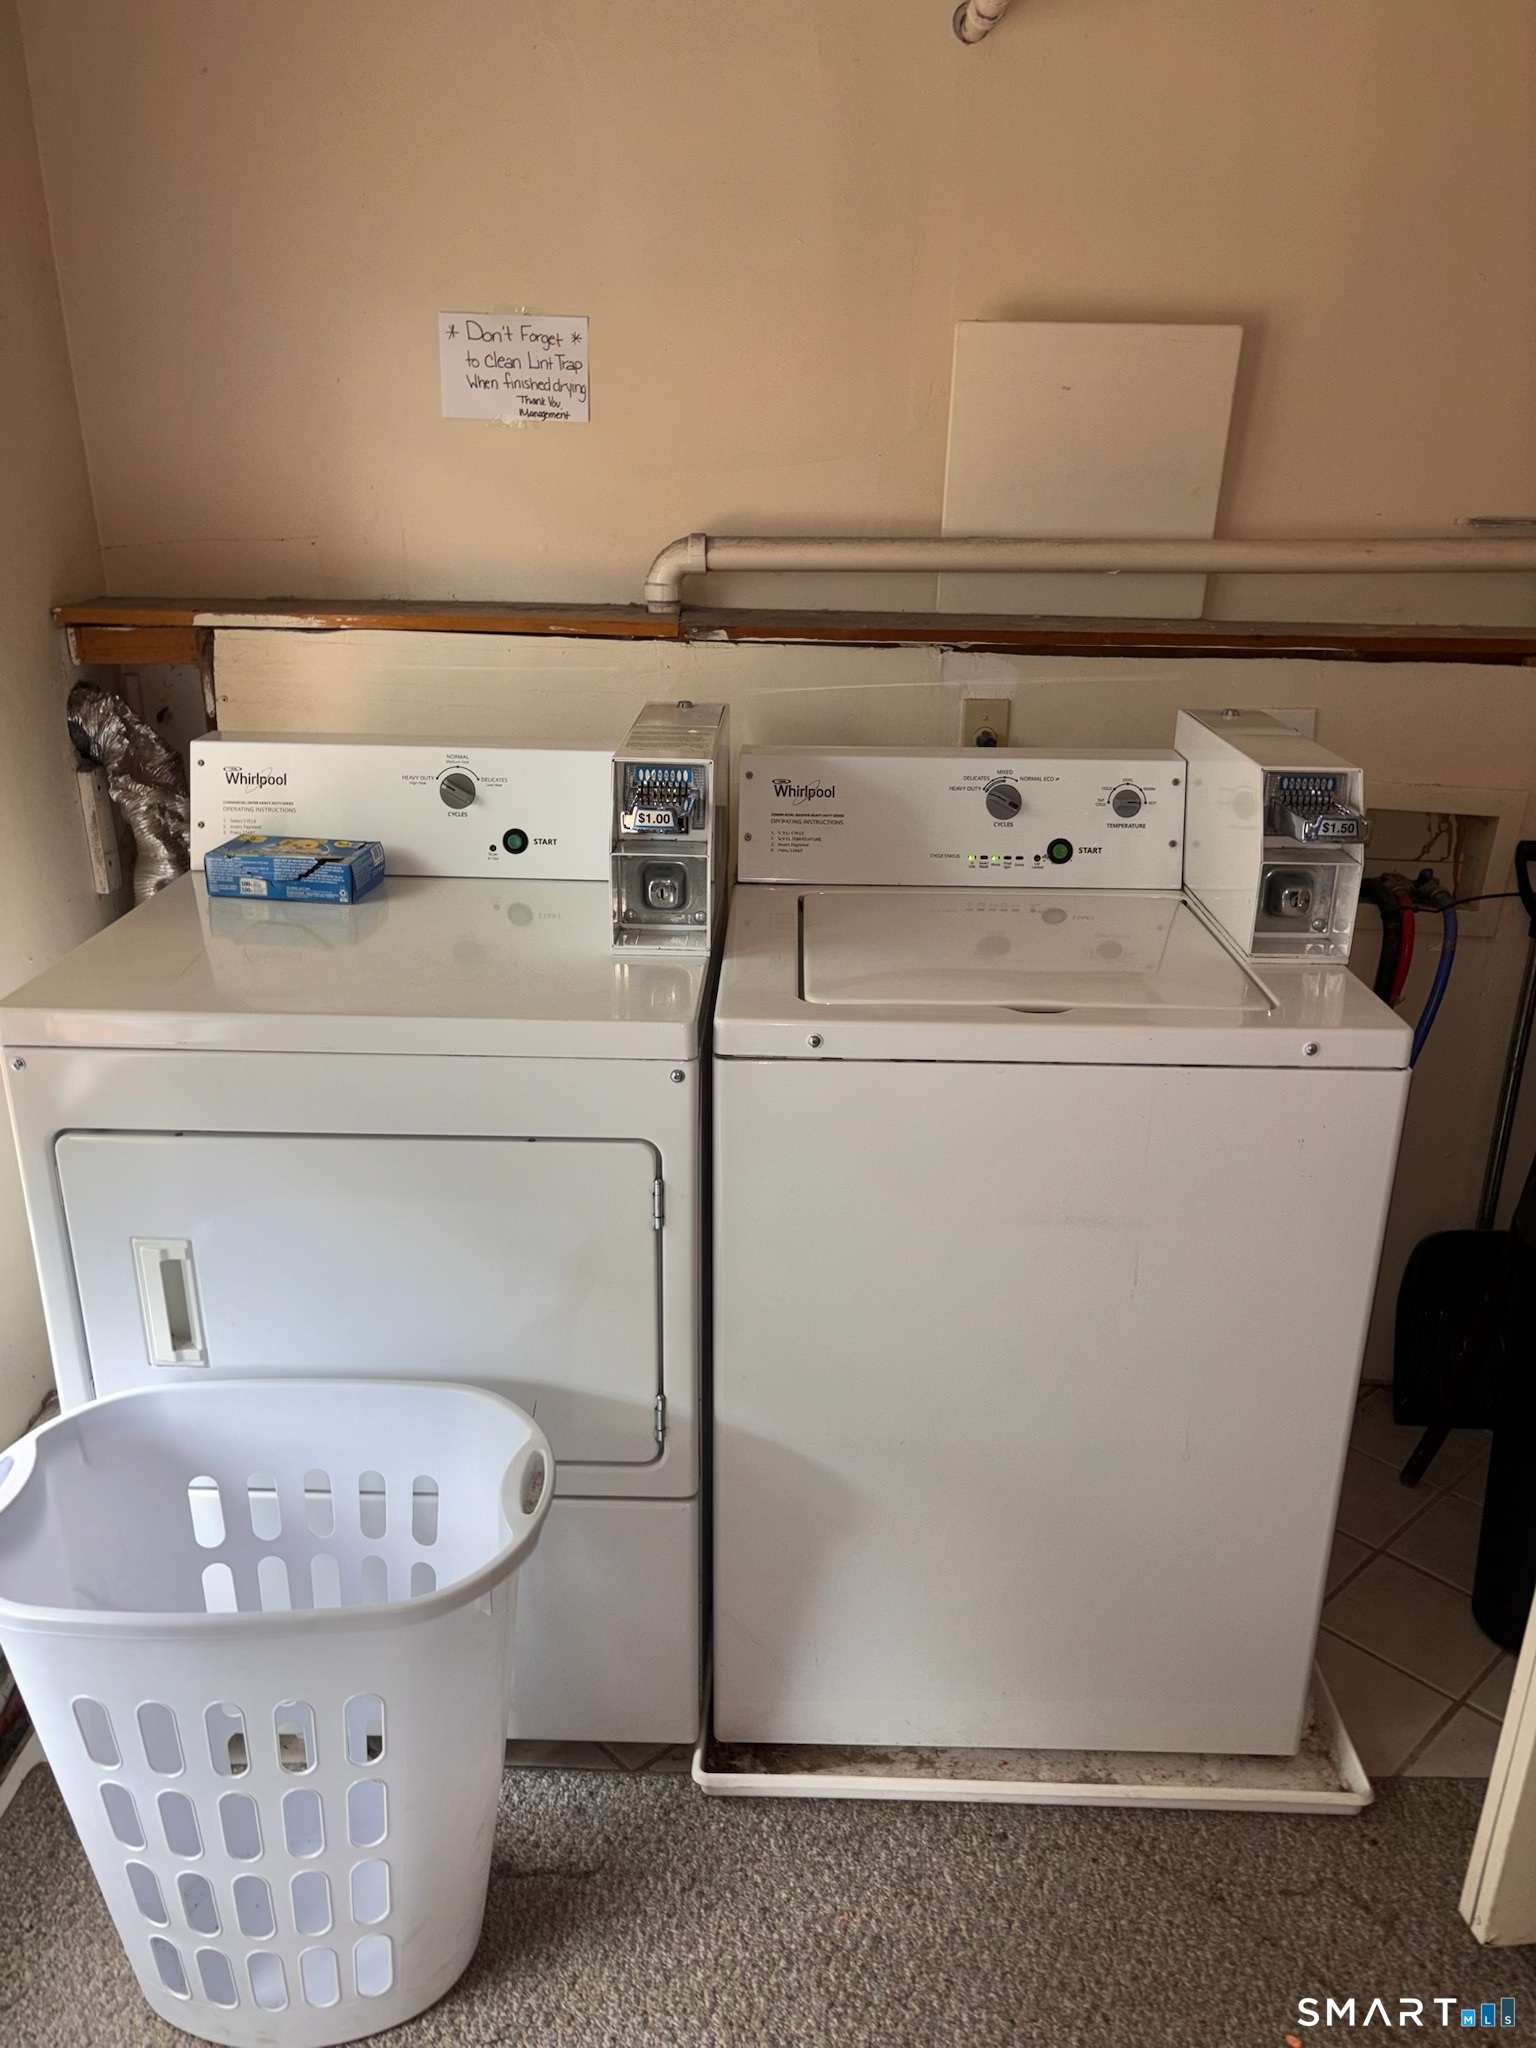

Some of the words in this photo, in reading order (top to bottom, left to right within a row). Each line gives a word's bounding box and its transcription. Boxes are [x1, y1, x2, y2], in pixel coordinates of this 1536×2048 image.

[465, 319, 513, 343] Don't
[520, 324, 563, 351] Forget
[465, 350, 480, 368] to
[528, 351, 554, 370] Lint
[554, 353, 583, 374] Trap
[465, 373, 499, 390] When
[503, 371, 551, 392] finished
[552, 378, 587, 403] drying
[516, 395, 546, 406] Thank
[518, 408, 571, 422] Management
[225, 771, 287, 789] Whirlpool
[773, 784, 836, 801] Whirlpool
[638, 812, 671, 825] $1.00
[1322, 822, 1355, 834] $1.50
[533, 838, 558, 846] START
